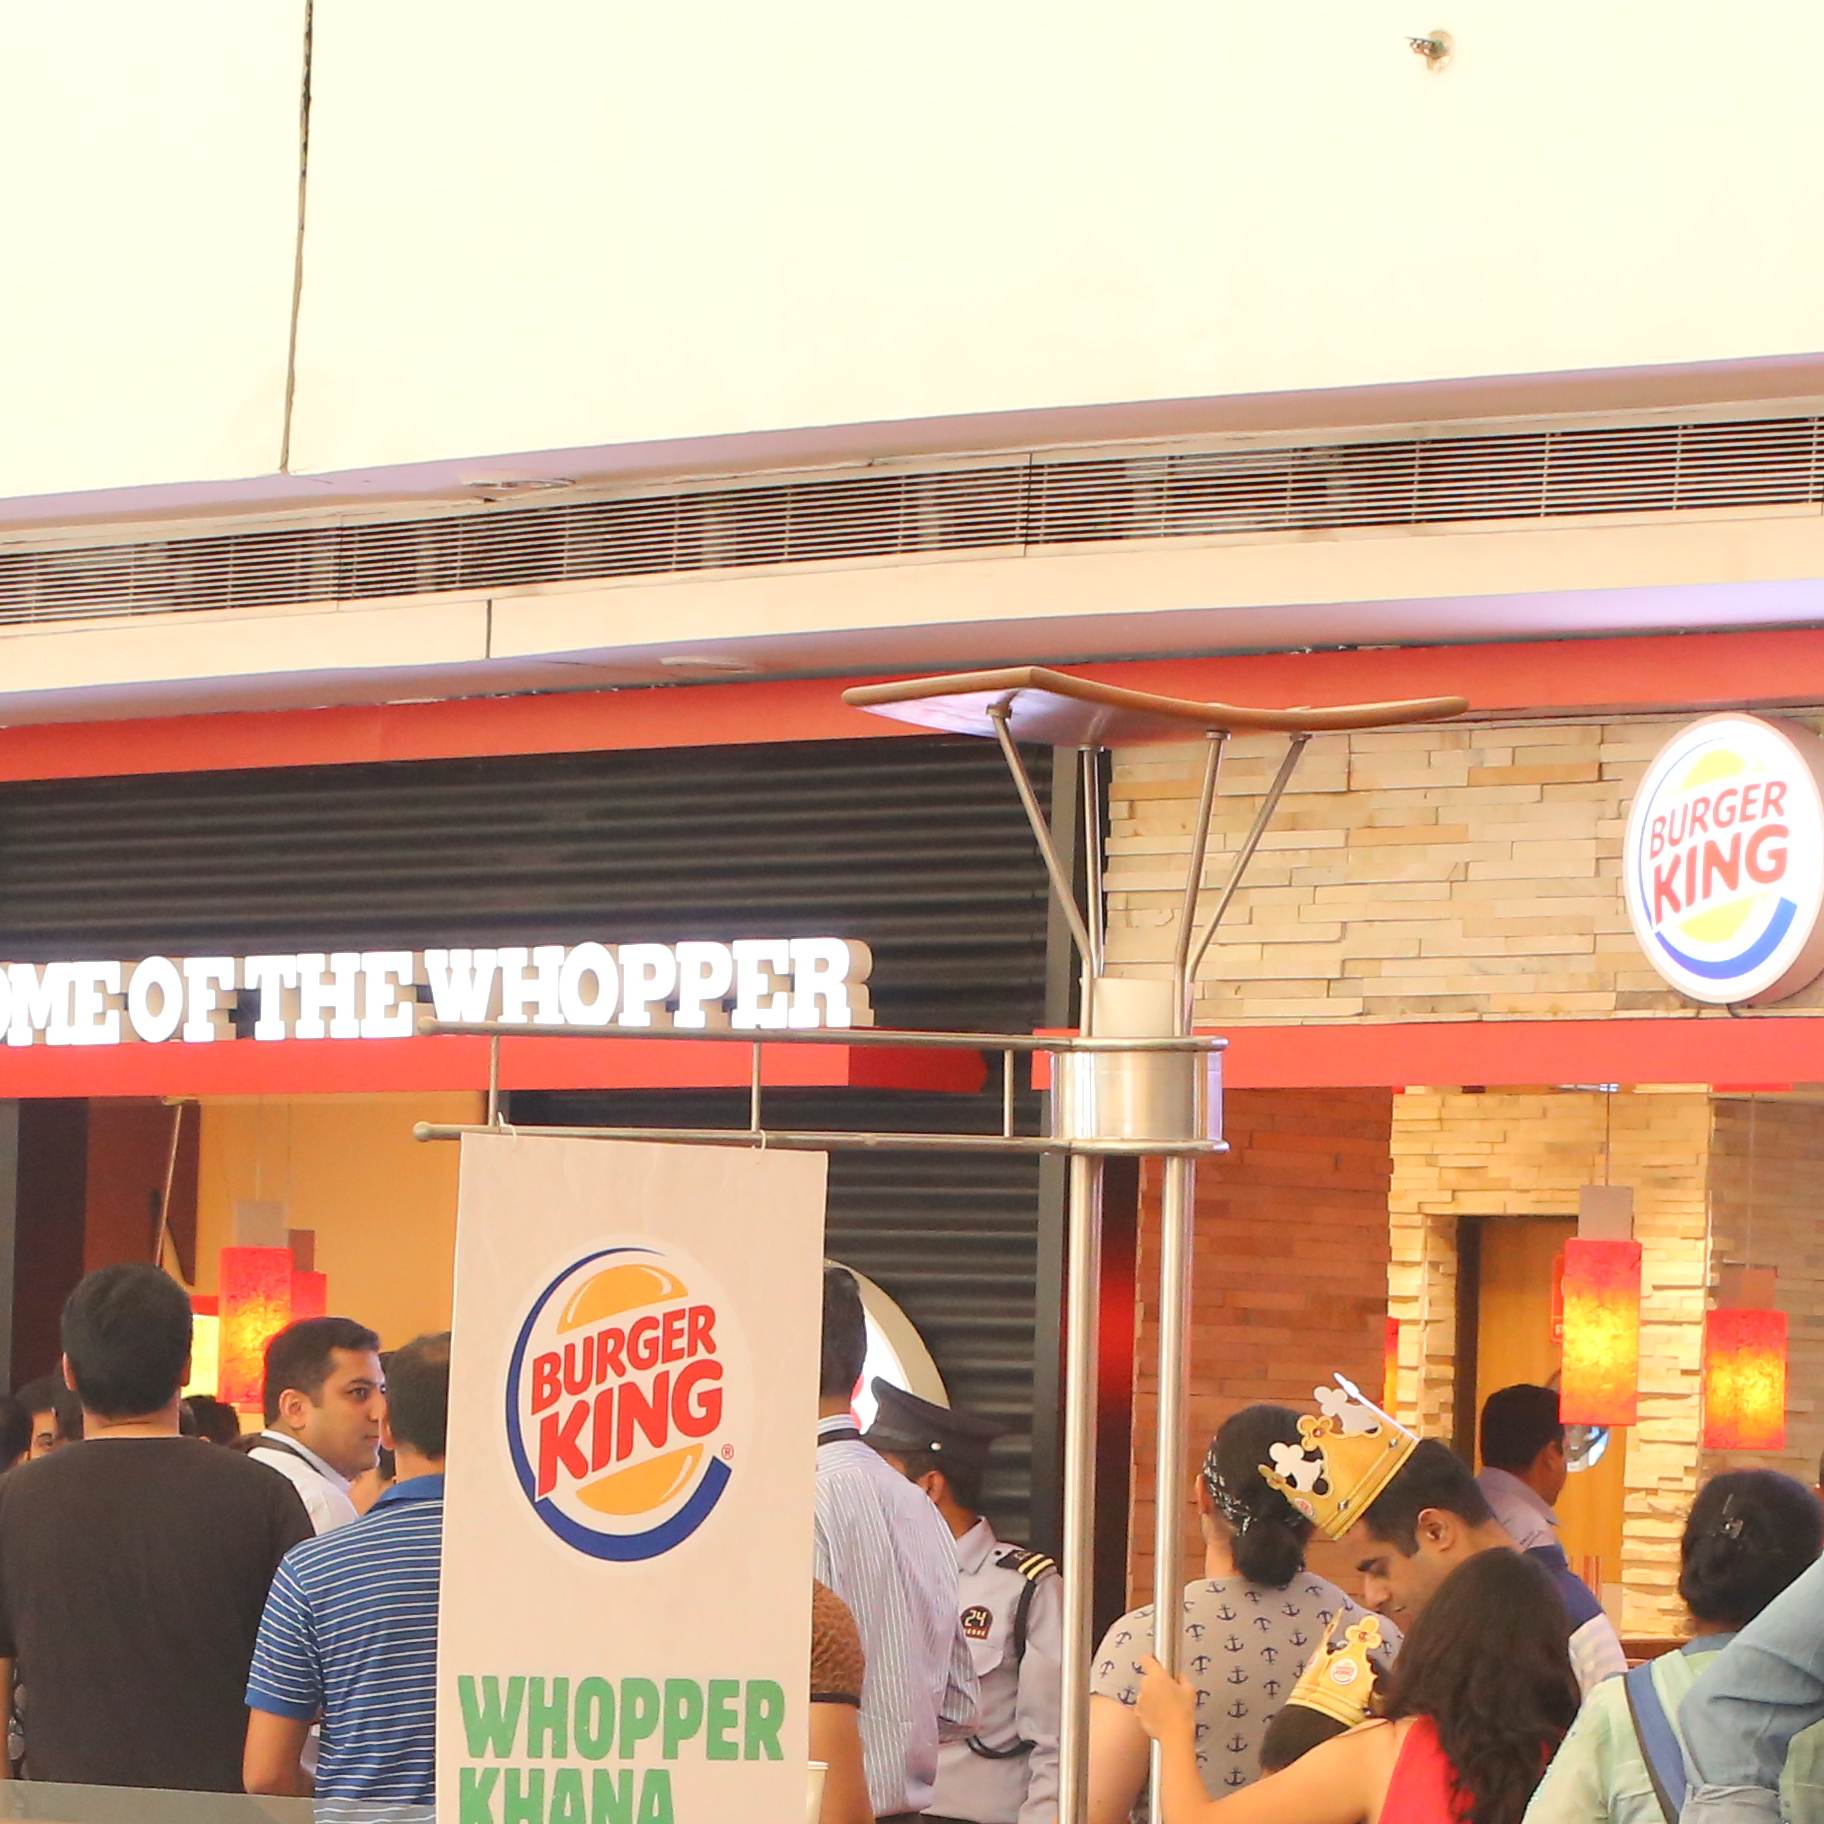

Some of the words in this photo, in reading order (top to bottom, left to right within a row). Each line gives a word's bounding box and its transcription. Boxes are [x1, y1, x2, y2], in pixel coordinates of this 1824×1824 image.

[1651, 780, 1788, 857] BURGER
[1653, 823, 1789, 928] KING
[128, 955, 235, 1044] OF
[245, 952, 415, 1040] THE
[424, 938, 854, 1032] WHOPPER
[530, 1304, 717, 1416] BURGER
[536, 1360, 724, 1501] KING
[965, 1609, 988, 1627] 24
[457, 1675, 786, 1761] WHOPPER
